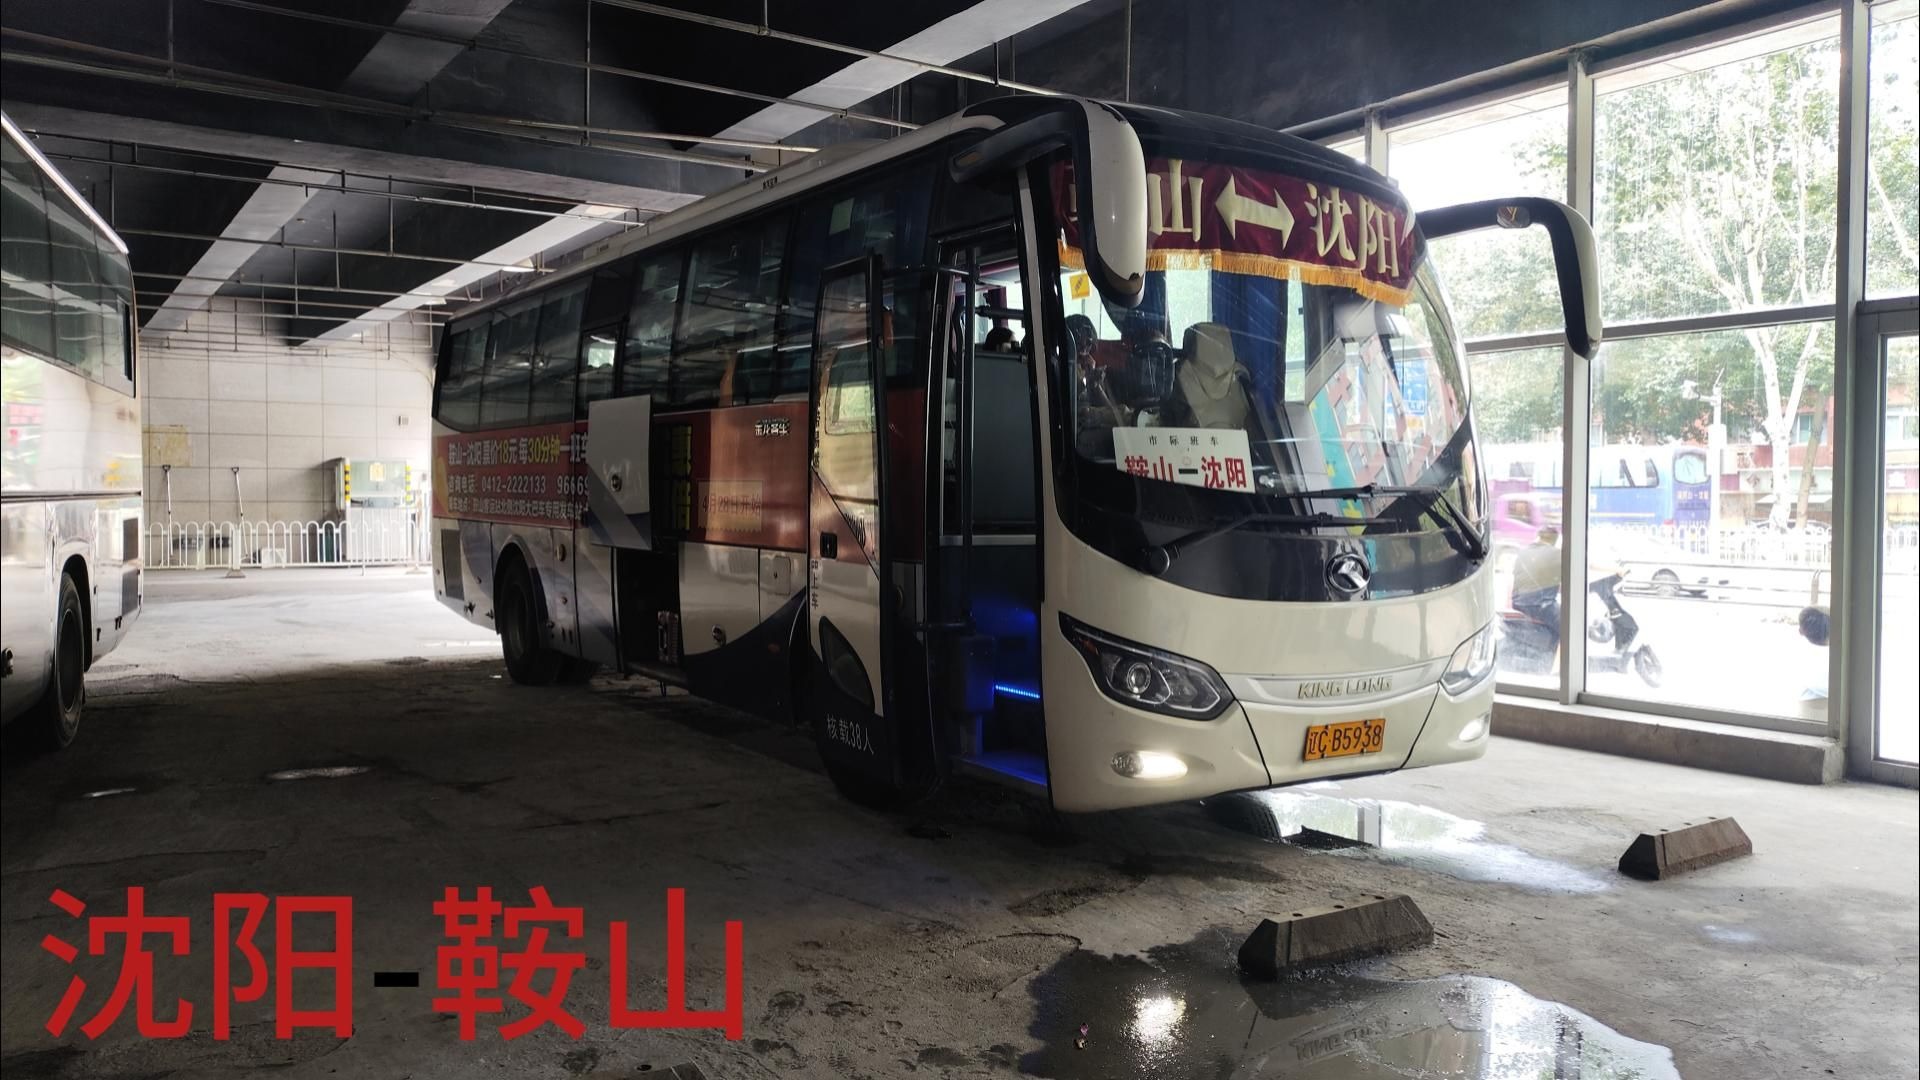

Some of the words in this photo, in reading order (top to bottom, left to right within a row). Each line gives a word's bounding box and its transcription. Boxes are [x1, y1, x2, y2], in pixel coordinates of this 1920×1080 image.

[1305, 182, 1400, 278] 沈阳
[1298, 679, 1343, 700] KING
[1346, 676, 1393, 695] LONG
[826, 714, 875, 756] 核载38人
